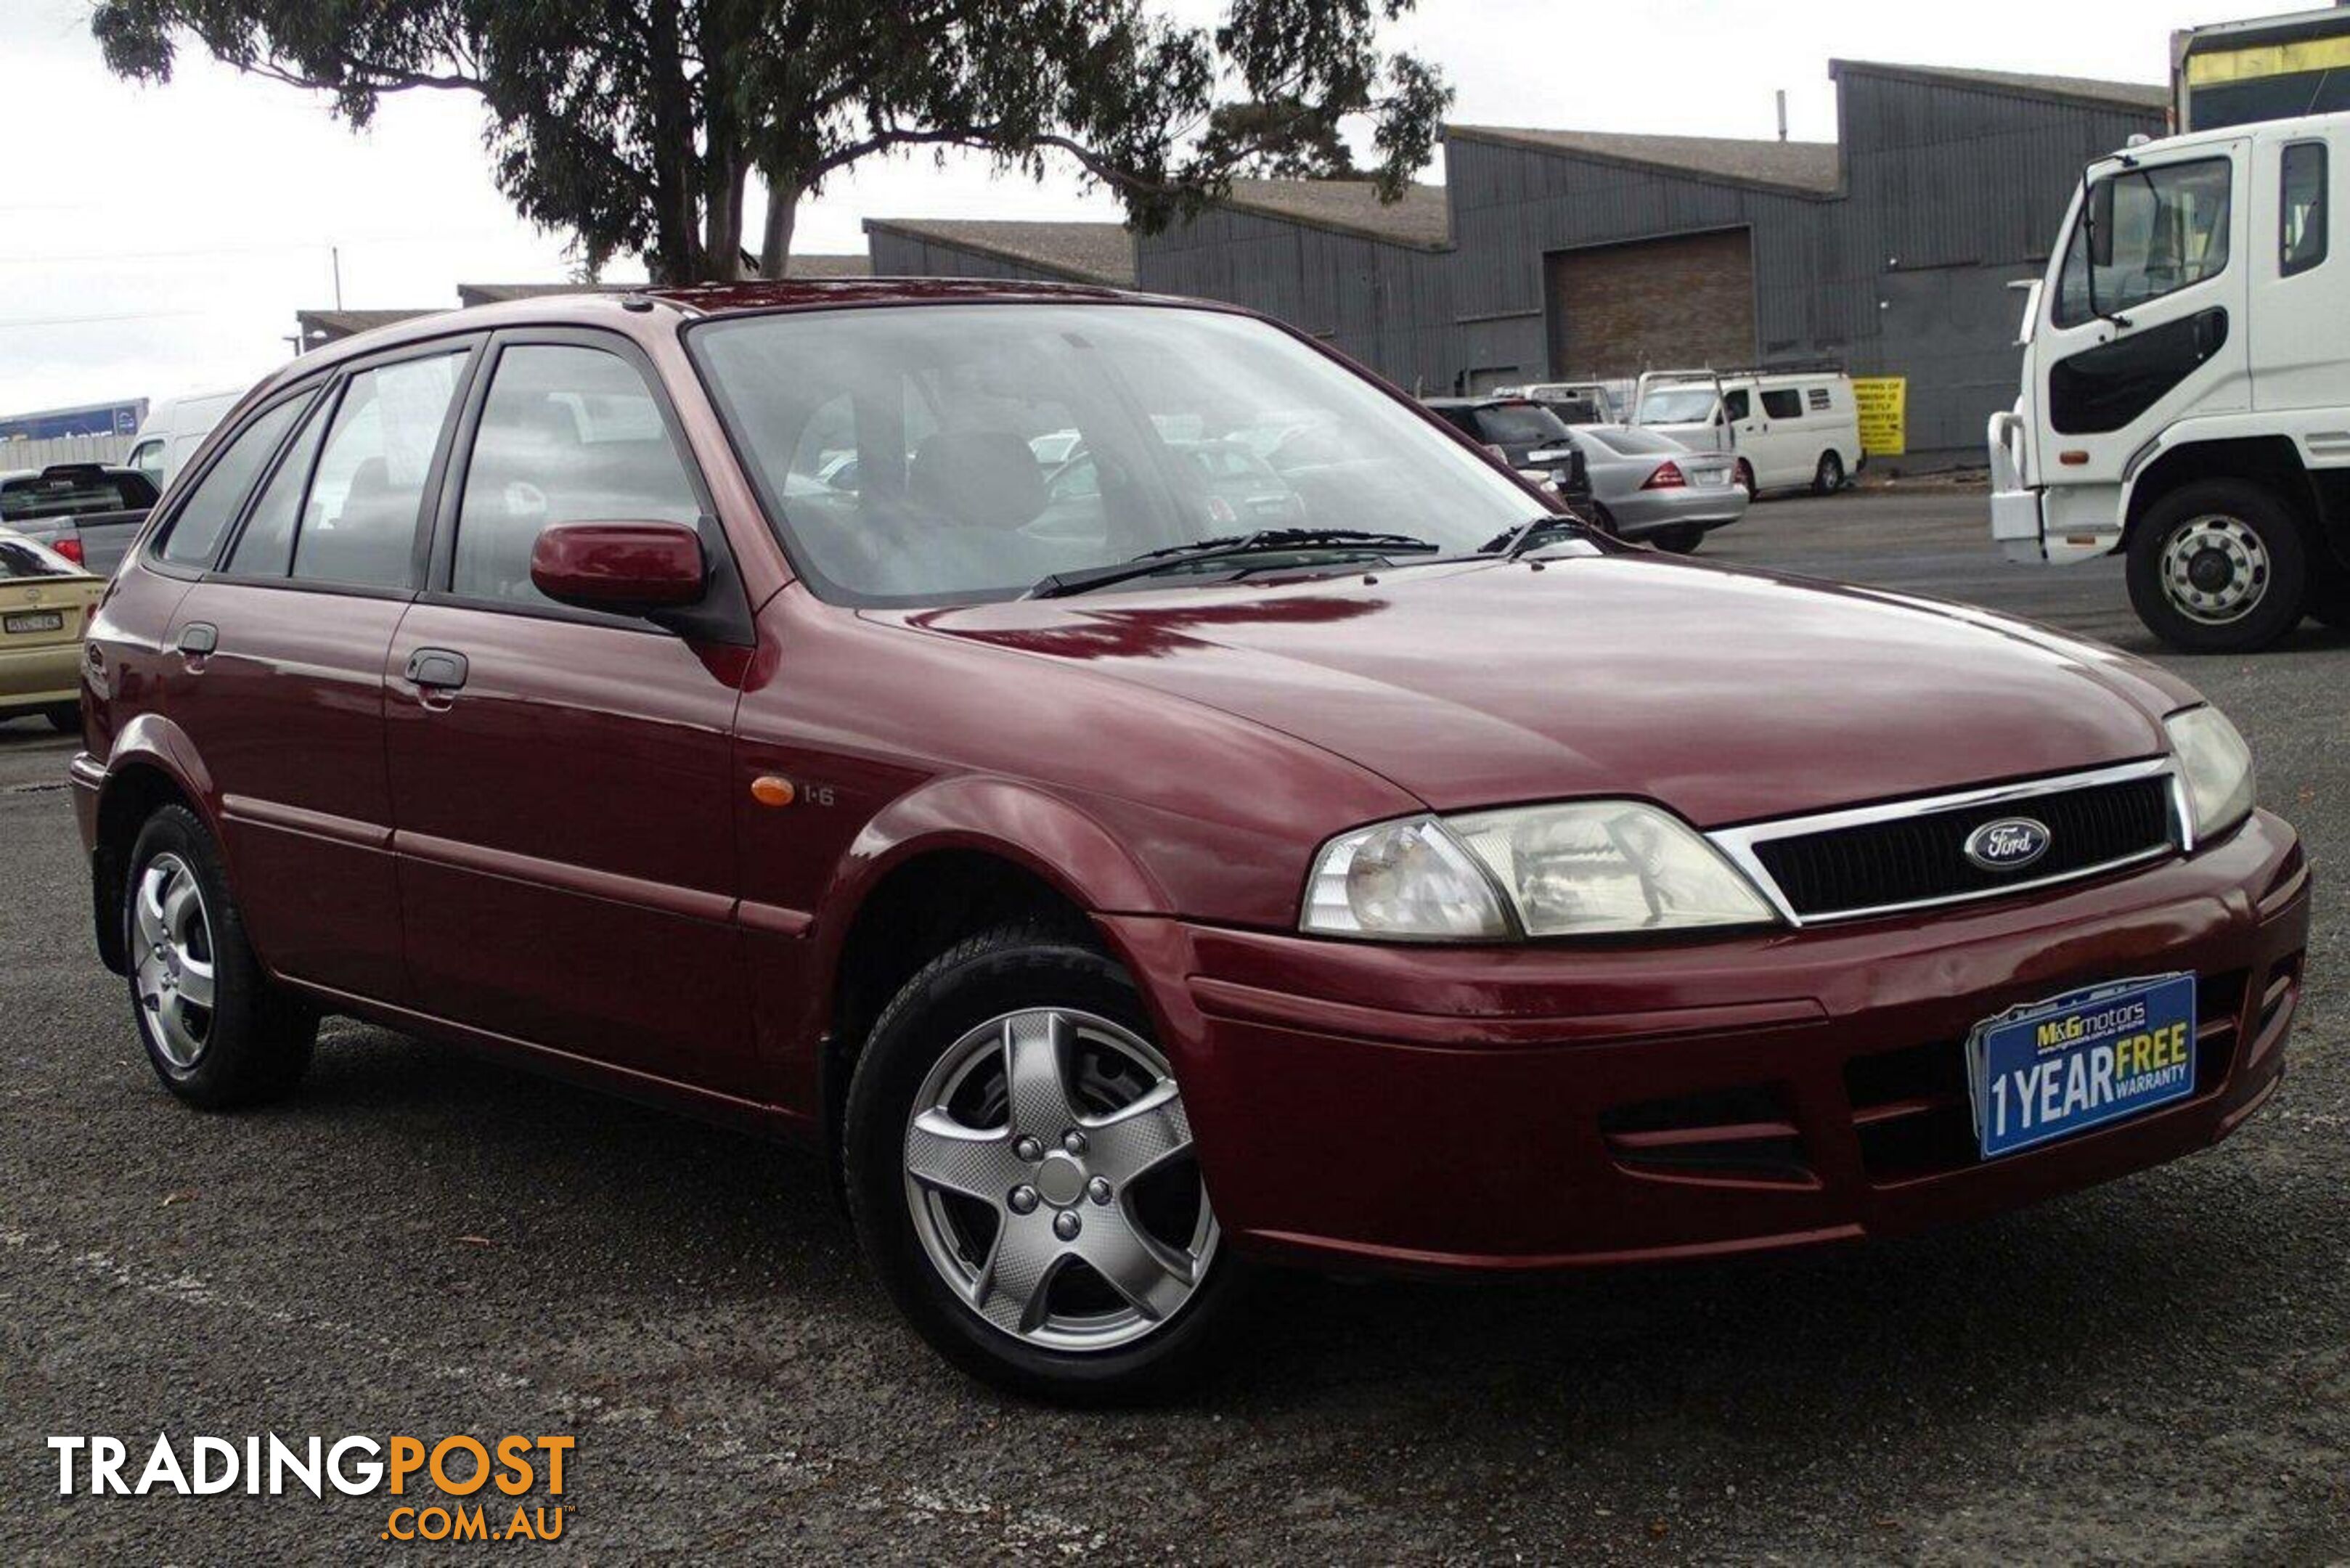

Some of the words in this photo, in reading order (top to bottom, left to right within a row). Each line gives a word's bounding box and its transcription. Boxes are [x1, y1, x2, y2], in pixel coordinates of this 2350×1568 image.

[1988, 827, 2031, 857] Ford
[2115, 1022, 2187, 1082] FREE
[2116, 1063, 2187, 1101] WARRANTY
